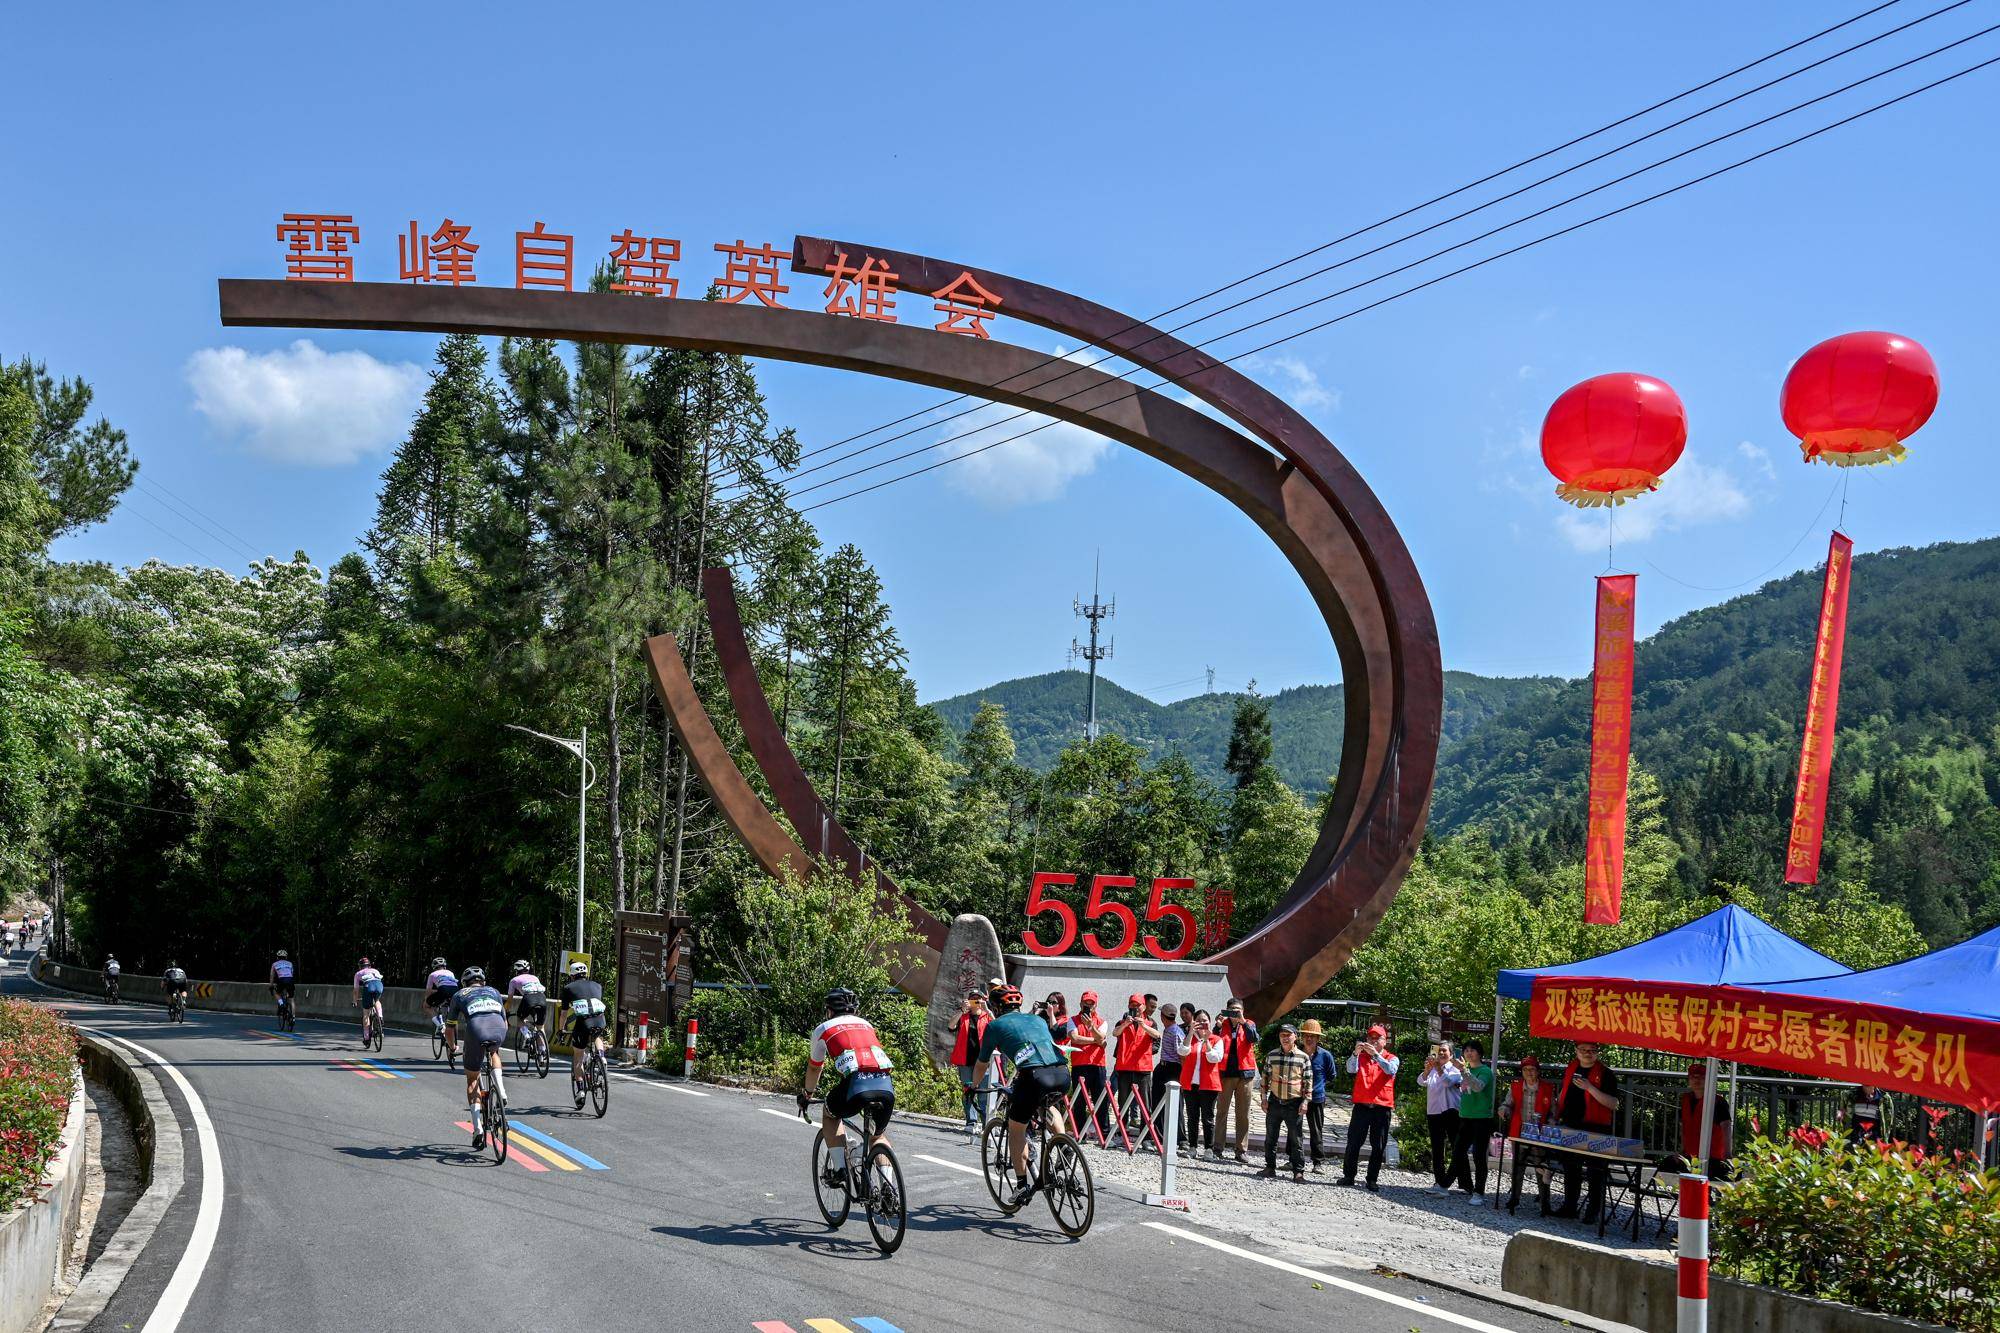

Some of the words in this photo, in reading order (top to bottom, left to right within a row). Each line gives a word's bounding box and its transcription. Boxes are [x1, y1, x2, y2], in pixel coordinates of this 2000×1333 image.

[276, 212, 1004, 339] 雪峰自驾英雄会
[1021, 871, 1197, 960] 555
[1543, 986, 1973, 1093] 双溪旅游度假村志愿者服务队
